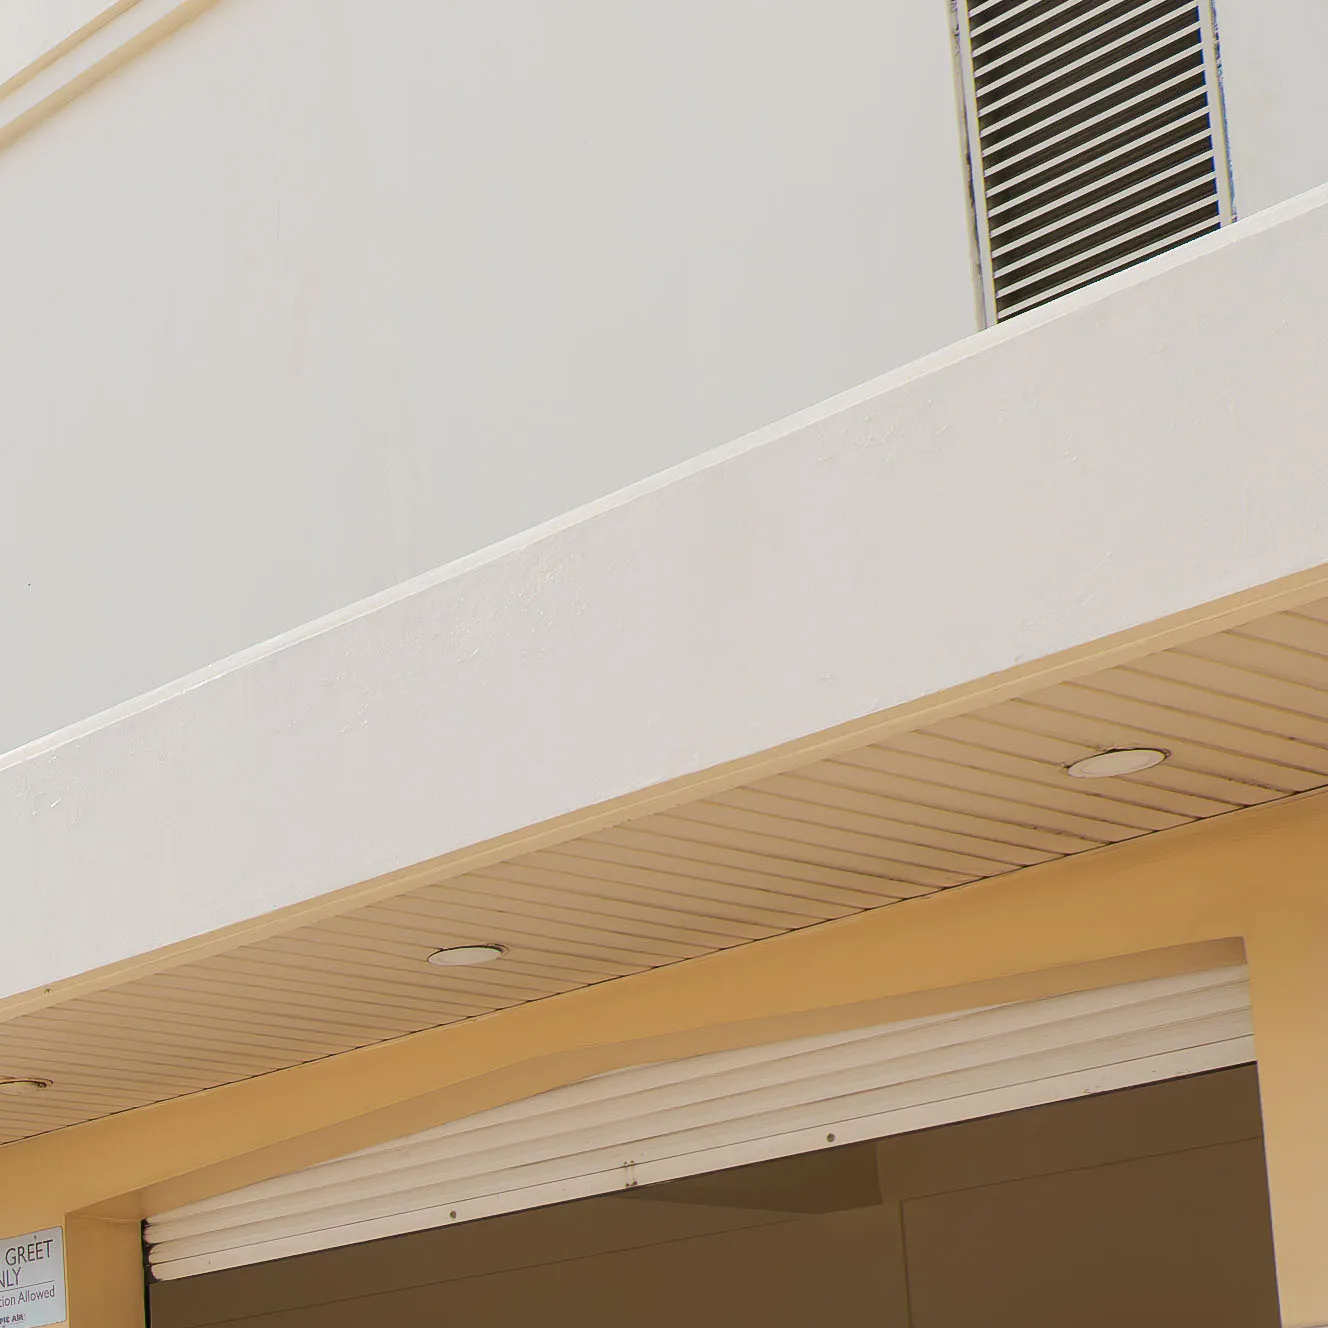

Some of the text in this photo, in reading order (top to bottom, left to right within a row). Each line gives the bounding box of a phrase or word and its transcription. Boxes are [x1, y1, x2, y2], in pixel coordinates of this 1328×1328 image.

[5, 1239, 54, 1266] GREET
[17, 1285, 55, 1304] Allowed
[11, 1313, 25, 1323] AIR
